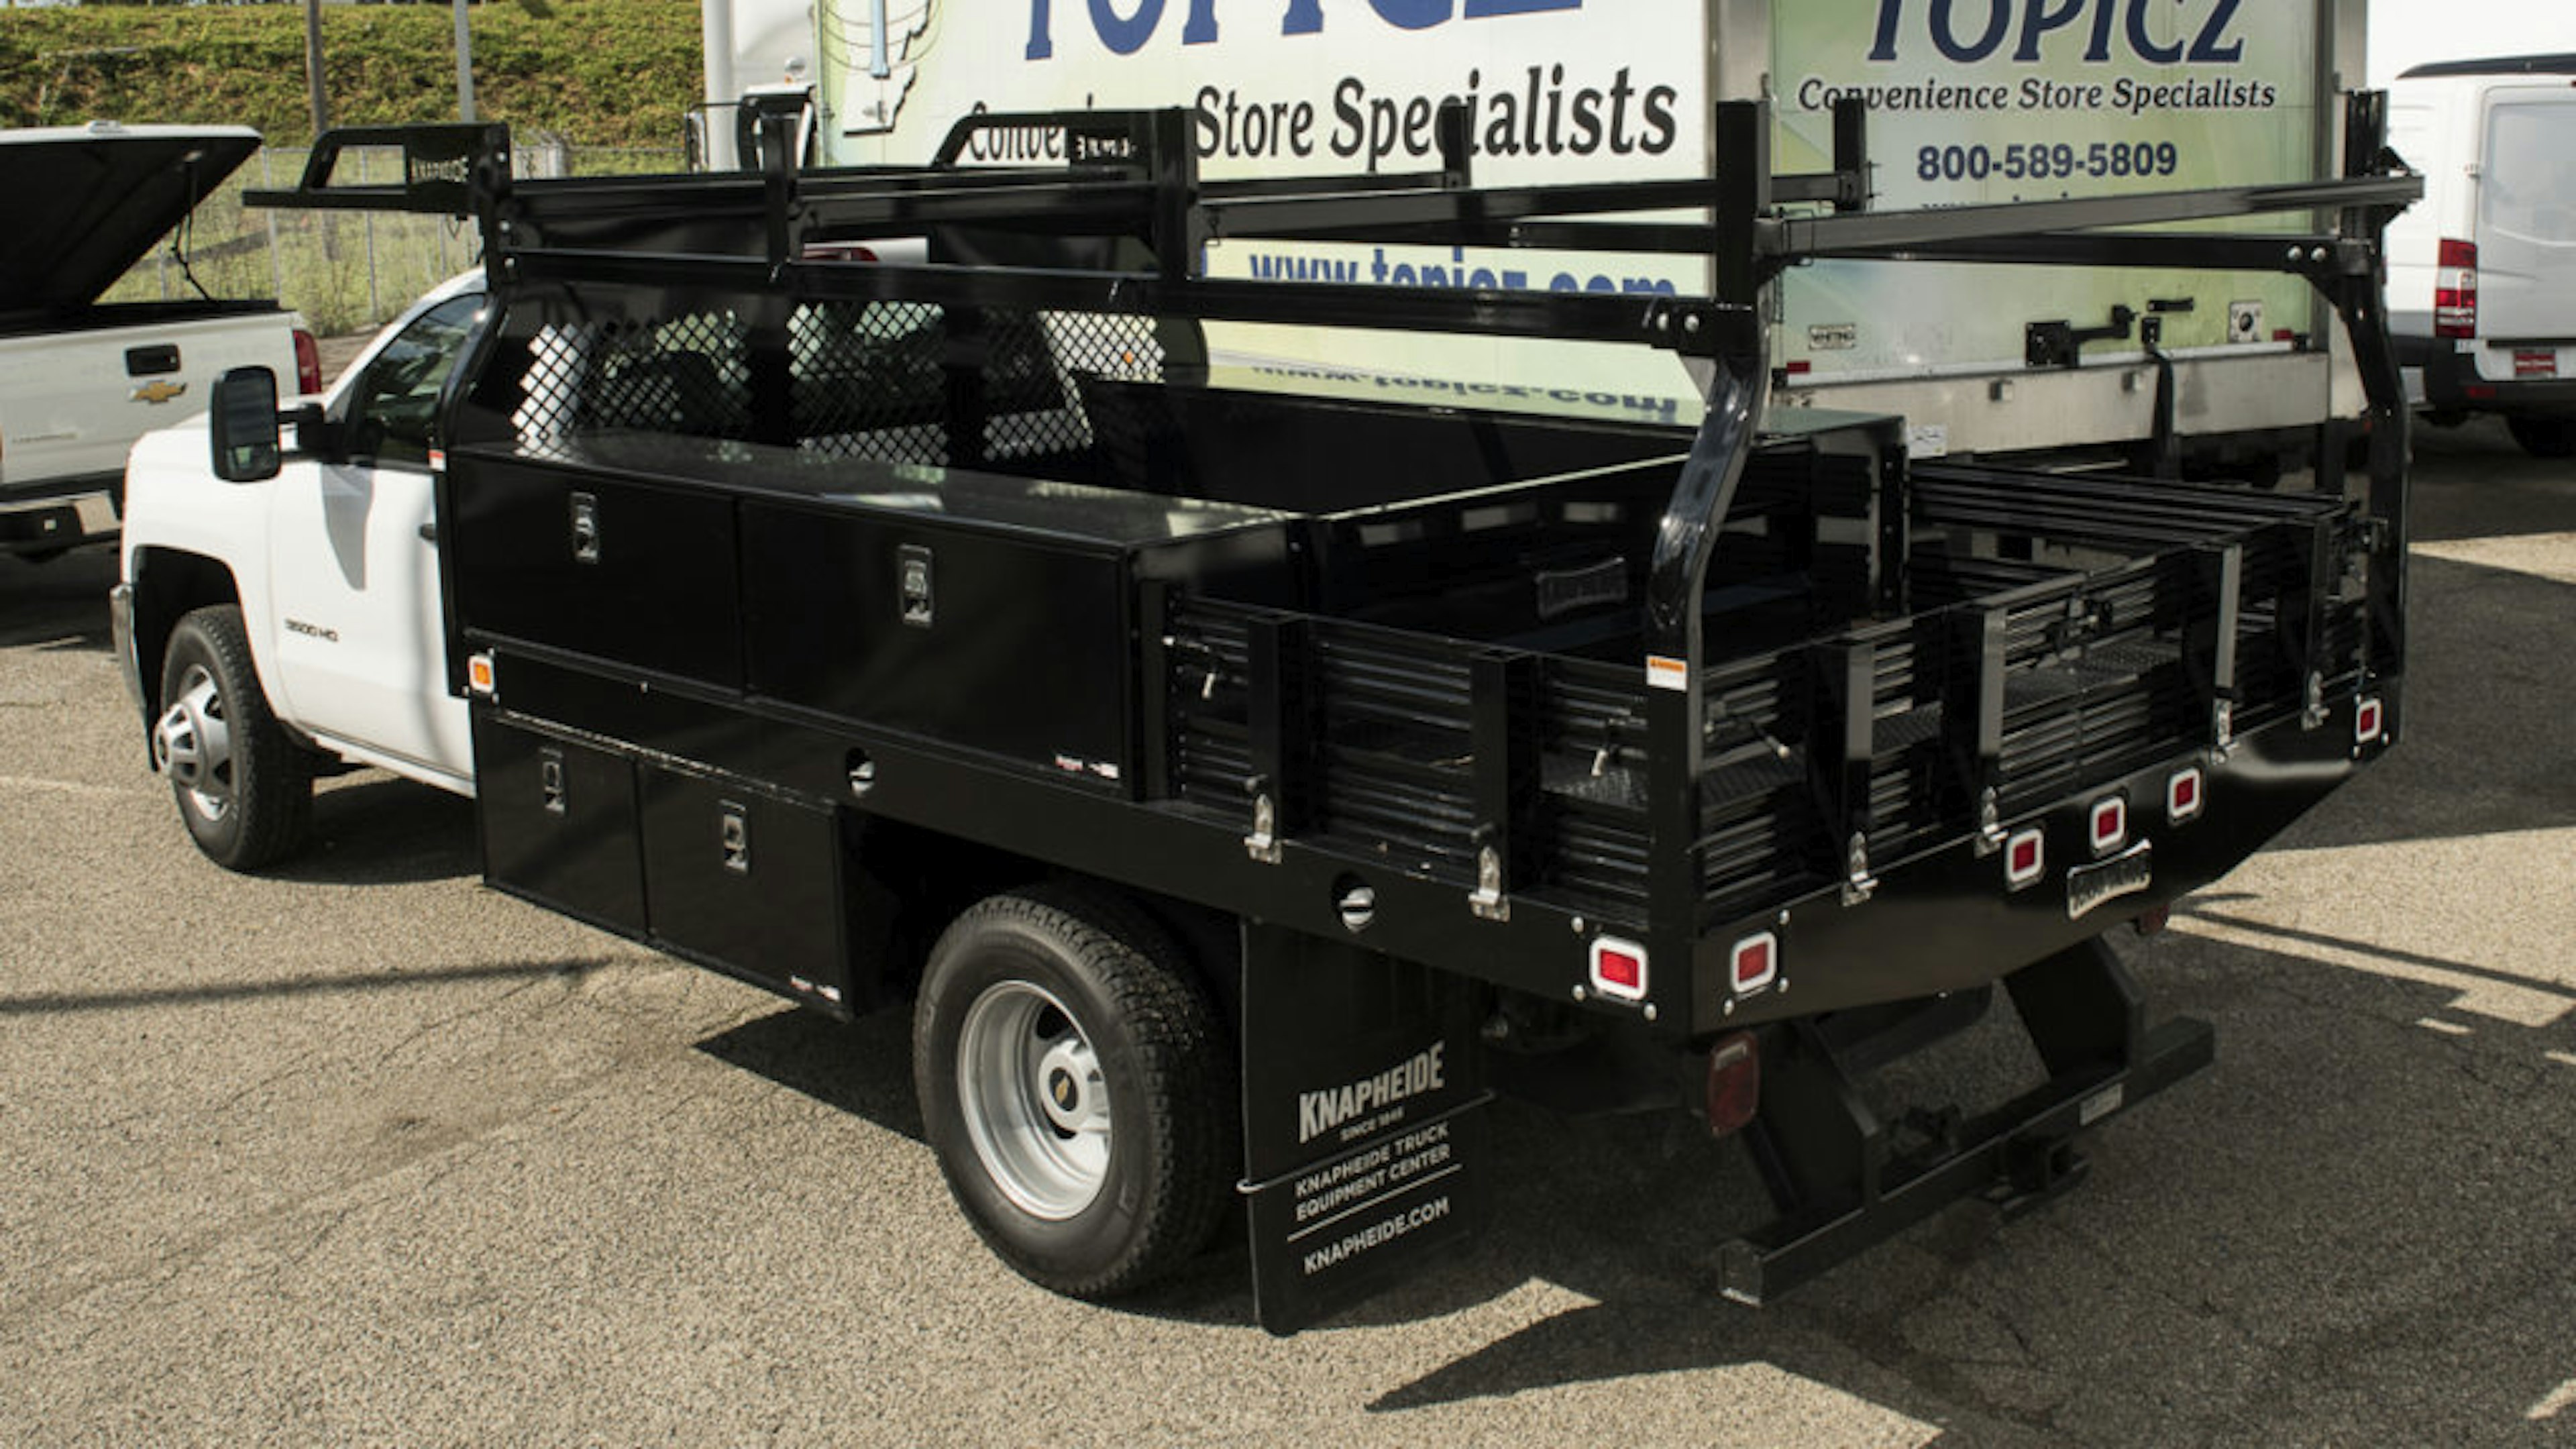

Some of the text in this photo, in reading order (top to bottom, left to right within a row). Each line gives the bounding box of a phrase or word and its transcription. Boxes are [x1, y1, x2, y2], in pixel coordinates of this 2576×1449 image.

[1195, 62, 1678, 173] Store Specialists
[1799, 77, 2275, 115] Convenience Store Specialists
[1917, 141, 2177, 181] 800-589-5809
[1299, 1039, 1445, 1144] KNAPHEIDE
[1295, 1121, 1450, 1198] KNAPHEIDE TRUCK
[1295, 1142, 1451, 1222] EQUIPMENT CENTER
[1303, 1196, 1451, 1276] KNAPHEIDE.COM
